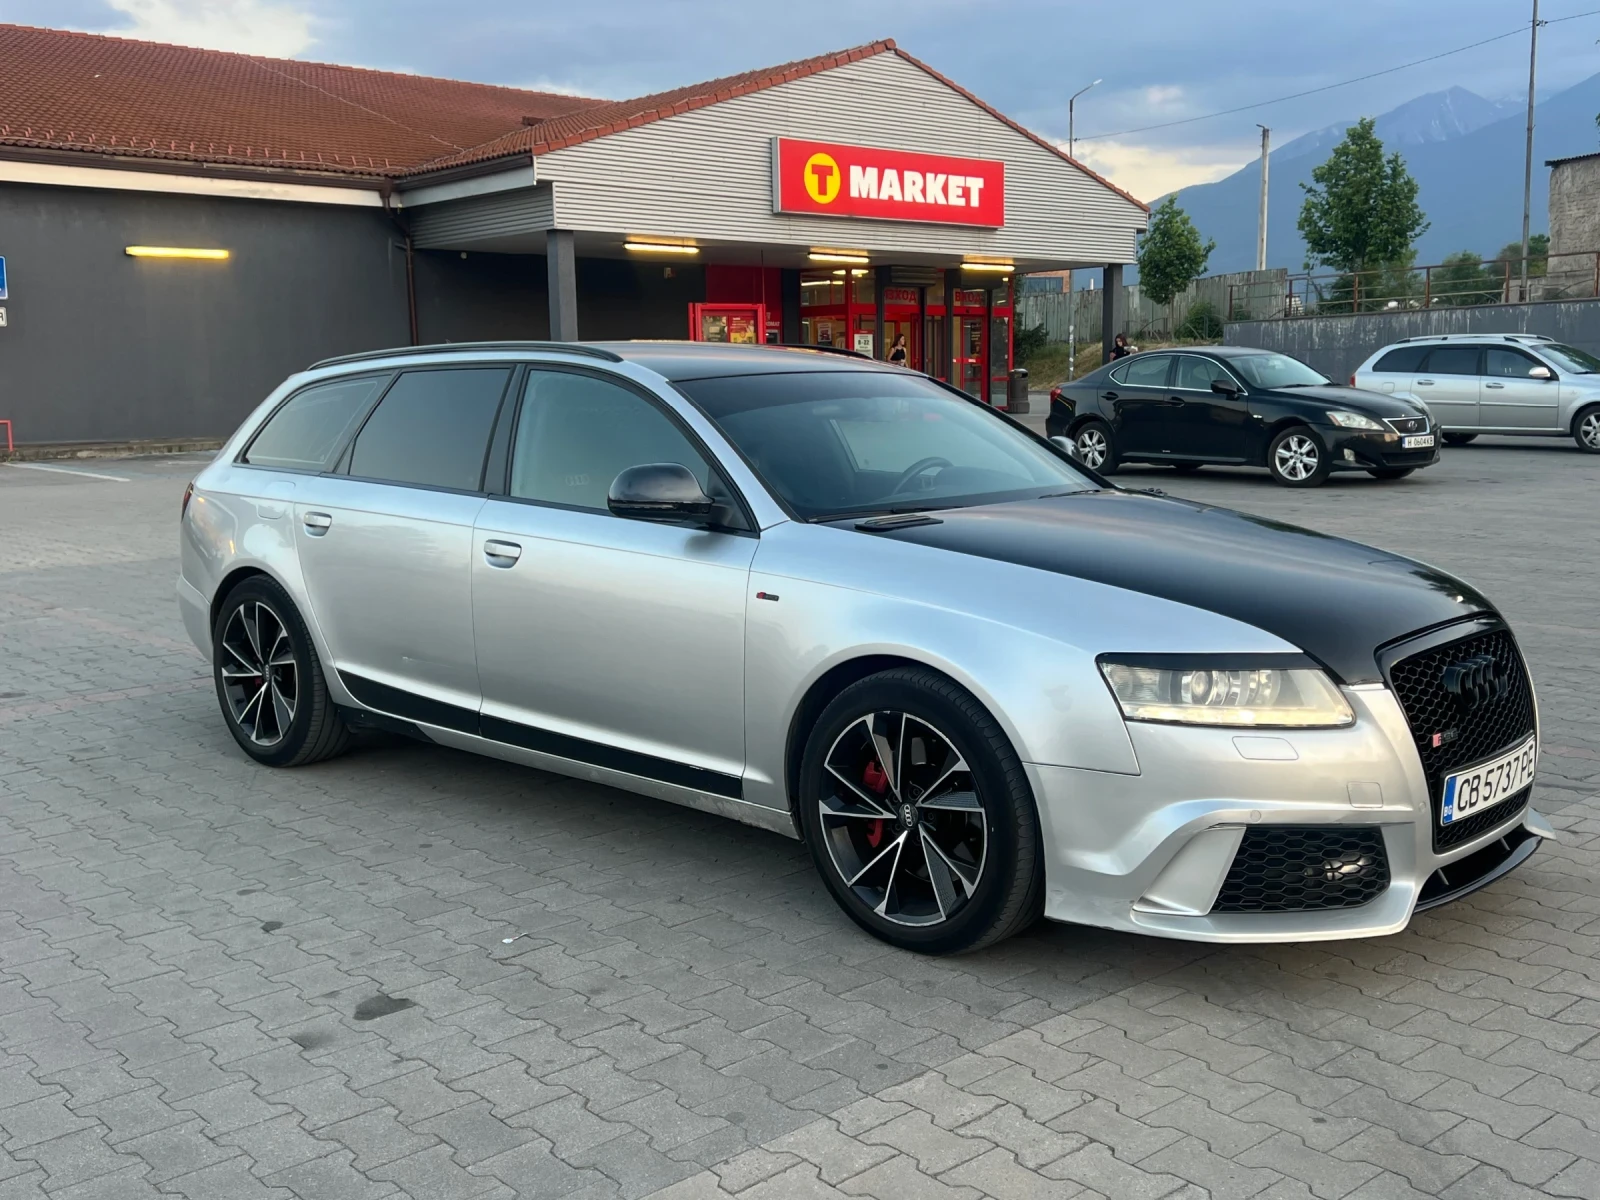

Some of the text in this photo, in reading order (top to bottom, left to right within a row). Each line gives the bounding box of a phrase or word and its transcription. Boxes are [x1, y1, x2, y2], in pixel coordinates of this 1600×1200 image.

[811, 163, 984, 207] T MARKET
[954, 291, 982, 304] ВХОД
[1457, 744, 1533, 812] CB 5737 PE
[1443, 805, 1453, 817] BG
